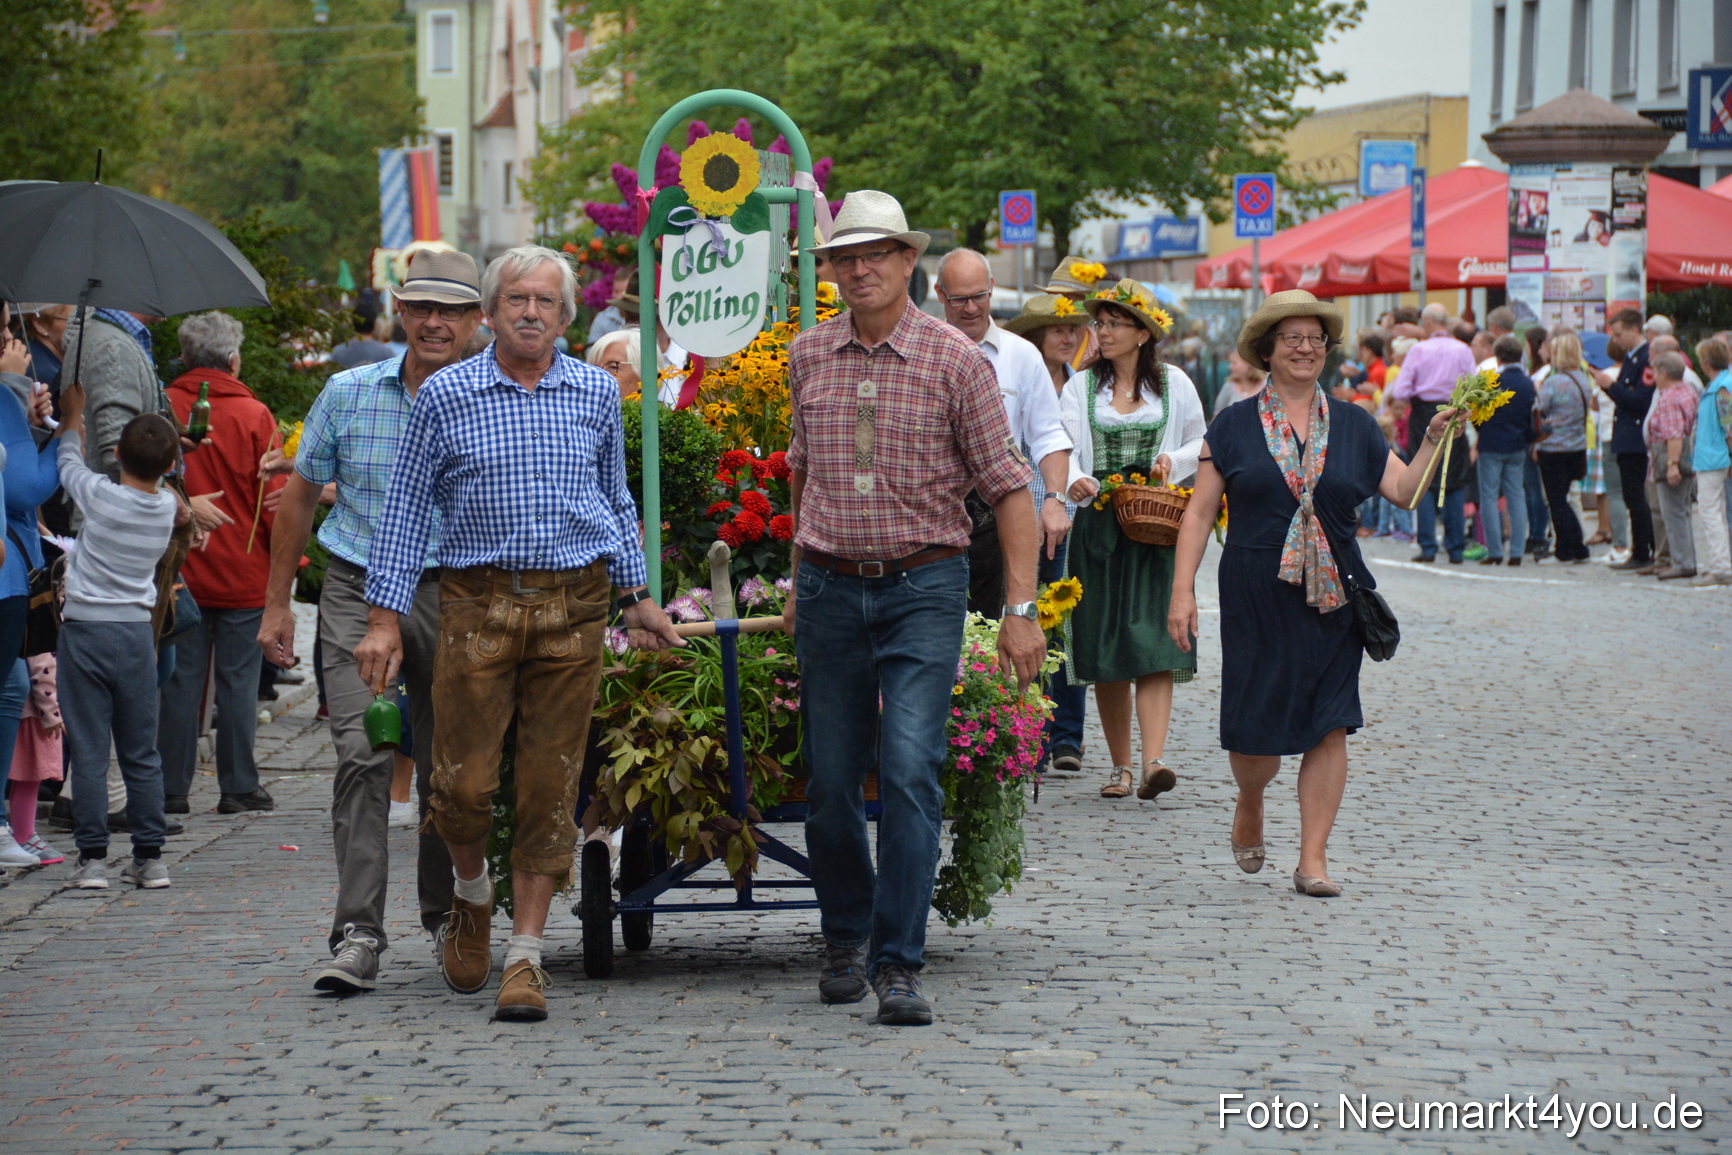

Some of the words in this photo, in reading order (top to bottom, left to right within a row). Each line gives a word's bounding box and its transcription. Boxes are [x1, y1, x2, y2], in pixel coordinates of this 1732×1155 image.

[1005, 226, 1033, 240] TAXI
[1238, 217, 1272, 234] TAXI
[1680, 260, 1716, 276] Hotel
[665, 285, 760, 336] Pölling
